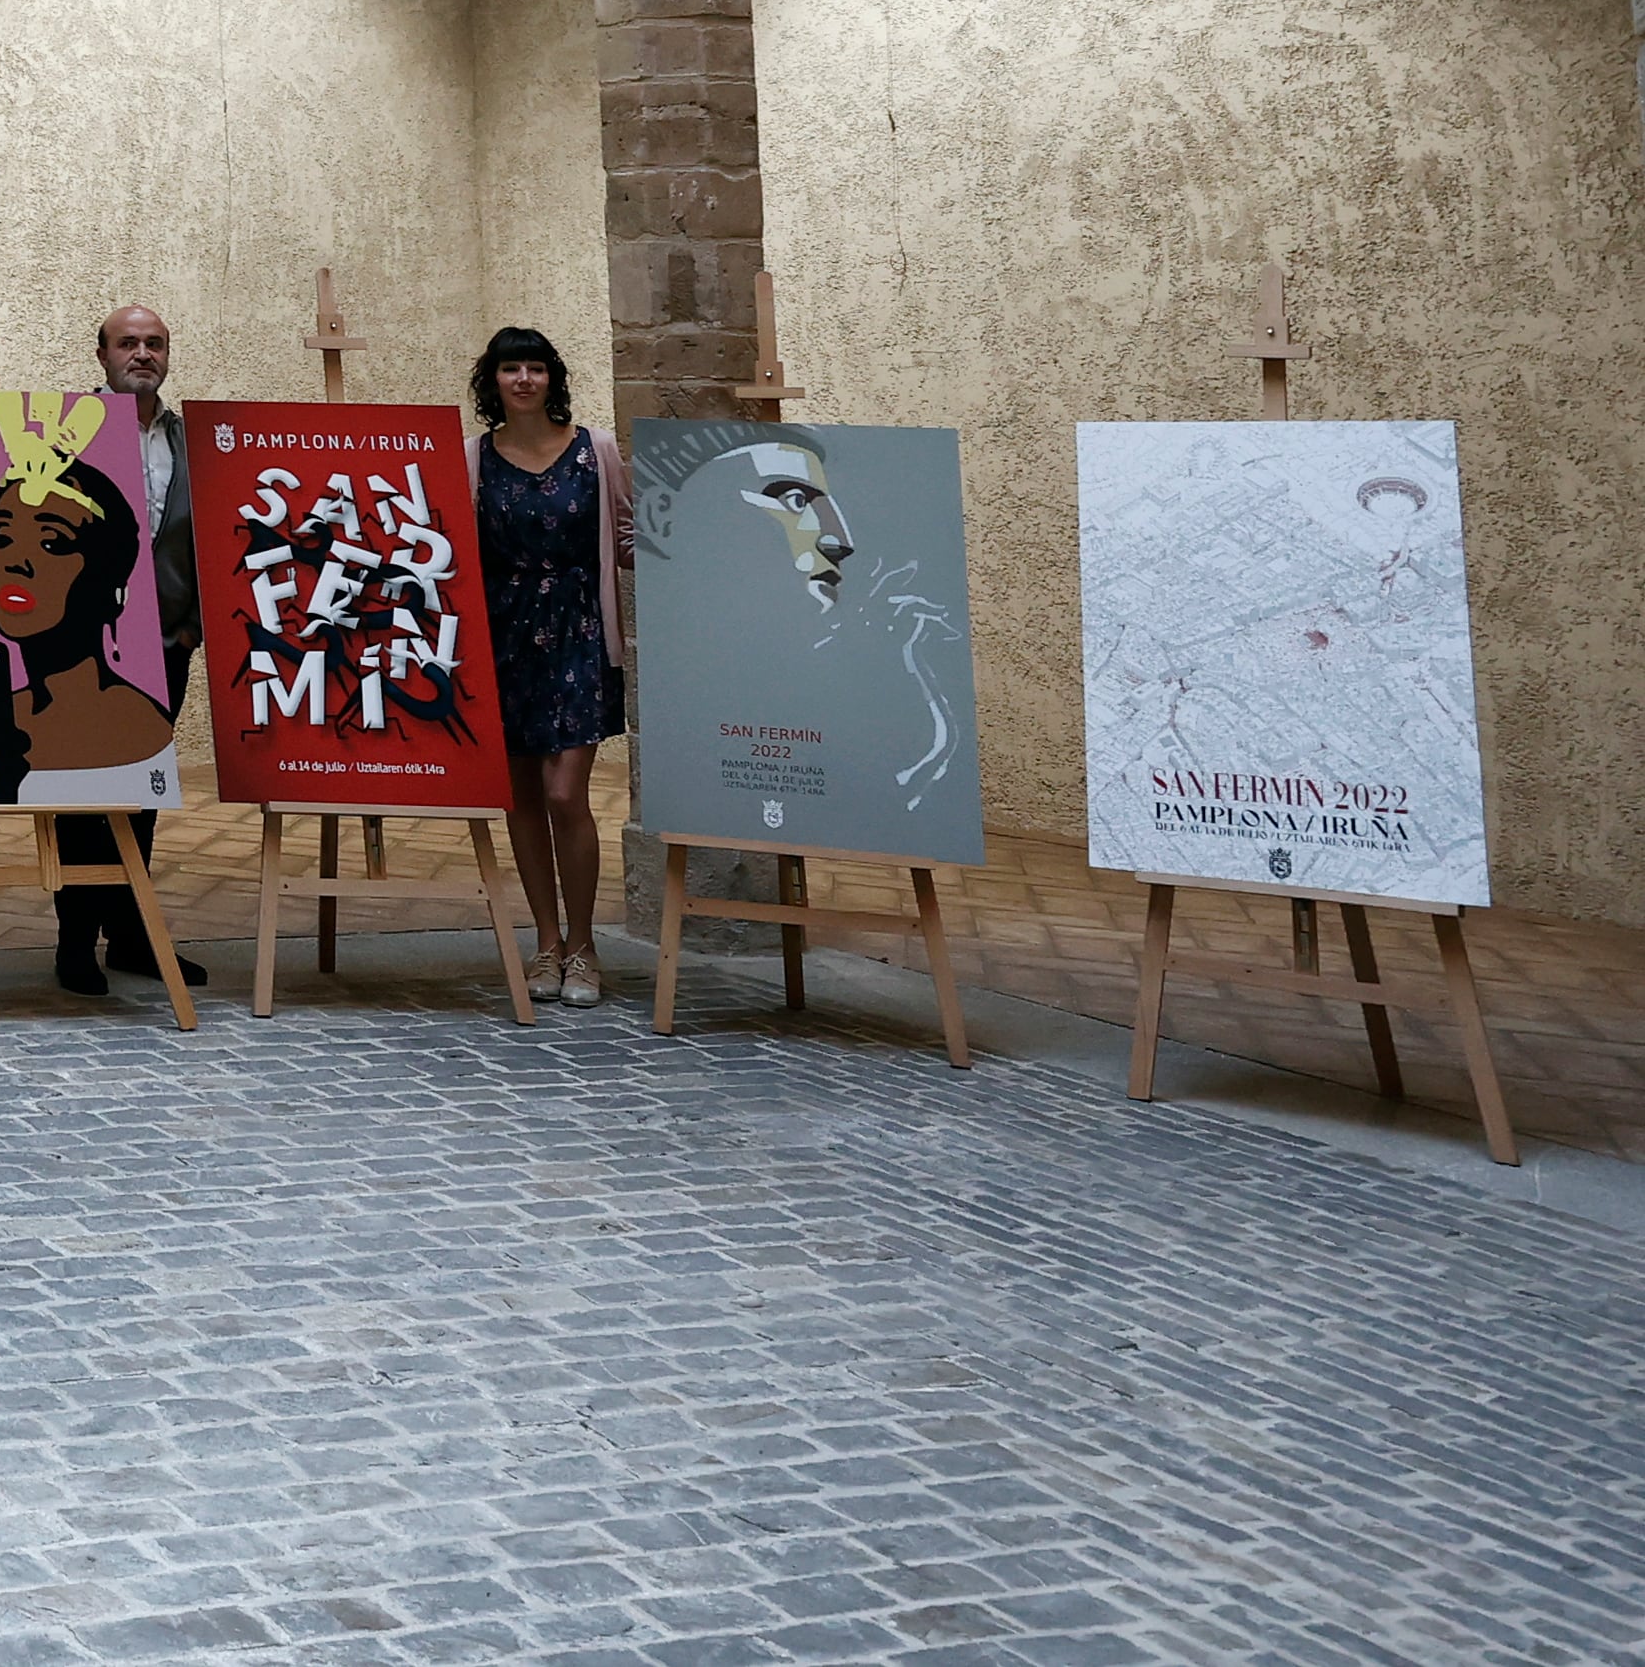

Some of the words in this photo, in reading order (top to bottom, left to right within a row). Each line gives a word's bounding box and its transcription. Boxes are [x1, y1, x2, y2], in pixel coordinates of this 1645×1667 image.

[237, 462, 432, 542] SAN
[720, 723, 753, 738] SAN
[750, 743, 791, 759] 2022
[278, 760, 286, 771] 6
[287, 761, 297, 771] al
[298, 760, 310, 771] 14
[311, 761, 324, 772] de
[324, 761, 346, 774] julio
[356, 761, 404, 774] Uztailaren
[405, 762, 423, 774] 6tik
[425, 763, 446, 775] 14ra
[721, 759, 780, 773] PAMPLONA
[1152, 768, 1206, 799] SAN
[1333, 781, 1410, 815] 2022
[1155, 801, 1298, 831] PAMPLONA
[1322, 814, 1410, 841] IRUÑA
